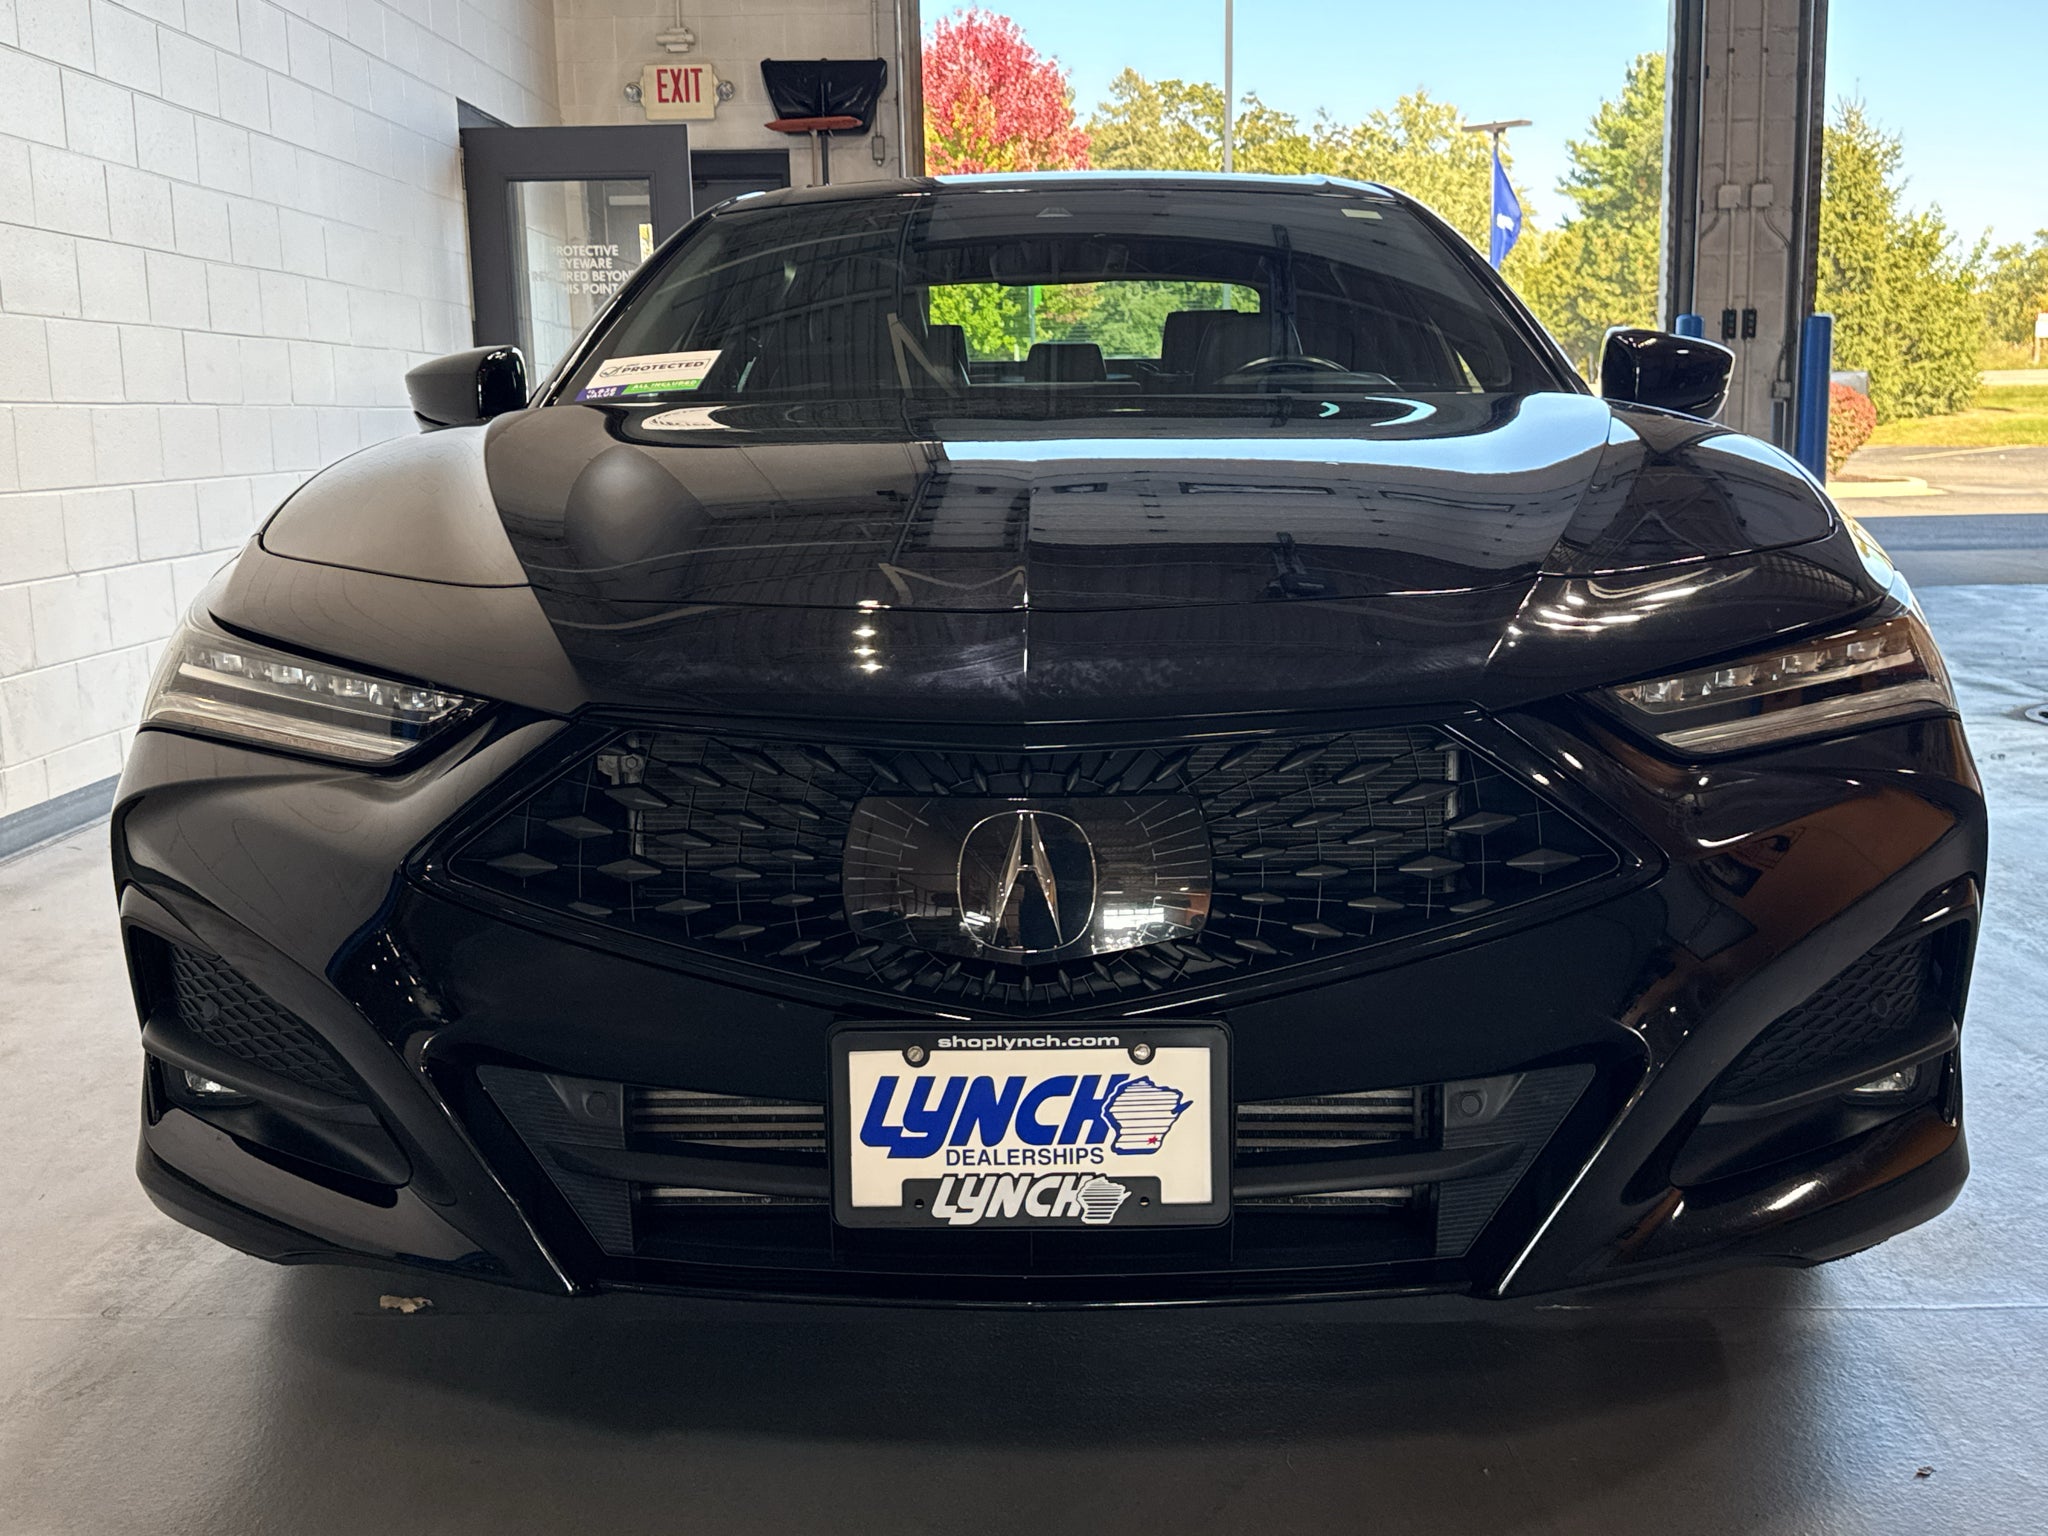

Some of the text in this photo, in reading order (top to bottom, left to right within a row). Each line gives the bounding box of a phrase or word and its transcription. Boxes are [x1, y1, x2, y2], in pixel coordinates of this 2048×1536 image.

[656, 68, 703, 103] EXIT
[551, 244, 619, 257] PROTECTIVE
[559, 257, 613, 269] EYEWARE
[582, 283, 619, 295] POINT
[621, 361, 704, 374] PROTECTED
[650, 379, 697, 387] INCLUDED
[938, 1035, 1120, 1051] shoplynch.com
[860, 1074, 1131, 1159] LYNCH
[946, 1147, 1104, 1166] DEALERSHIPS
[931, 1173, 1090, 1225] LYNCH
